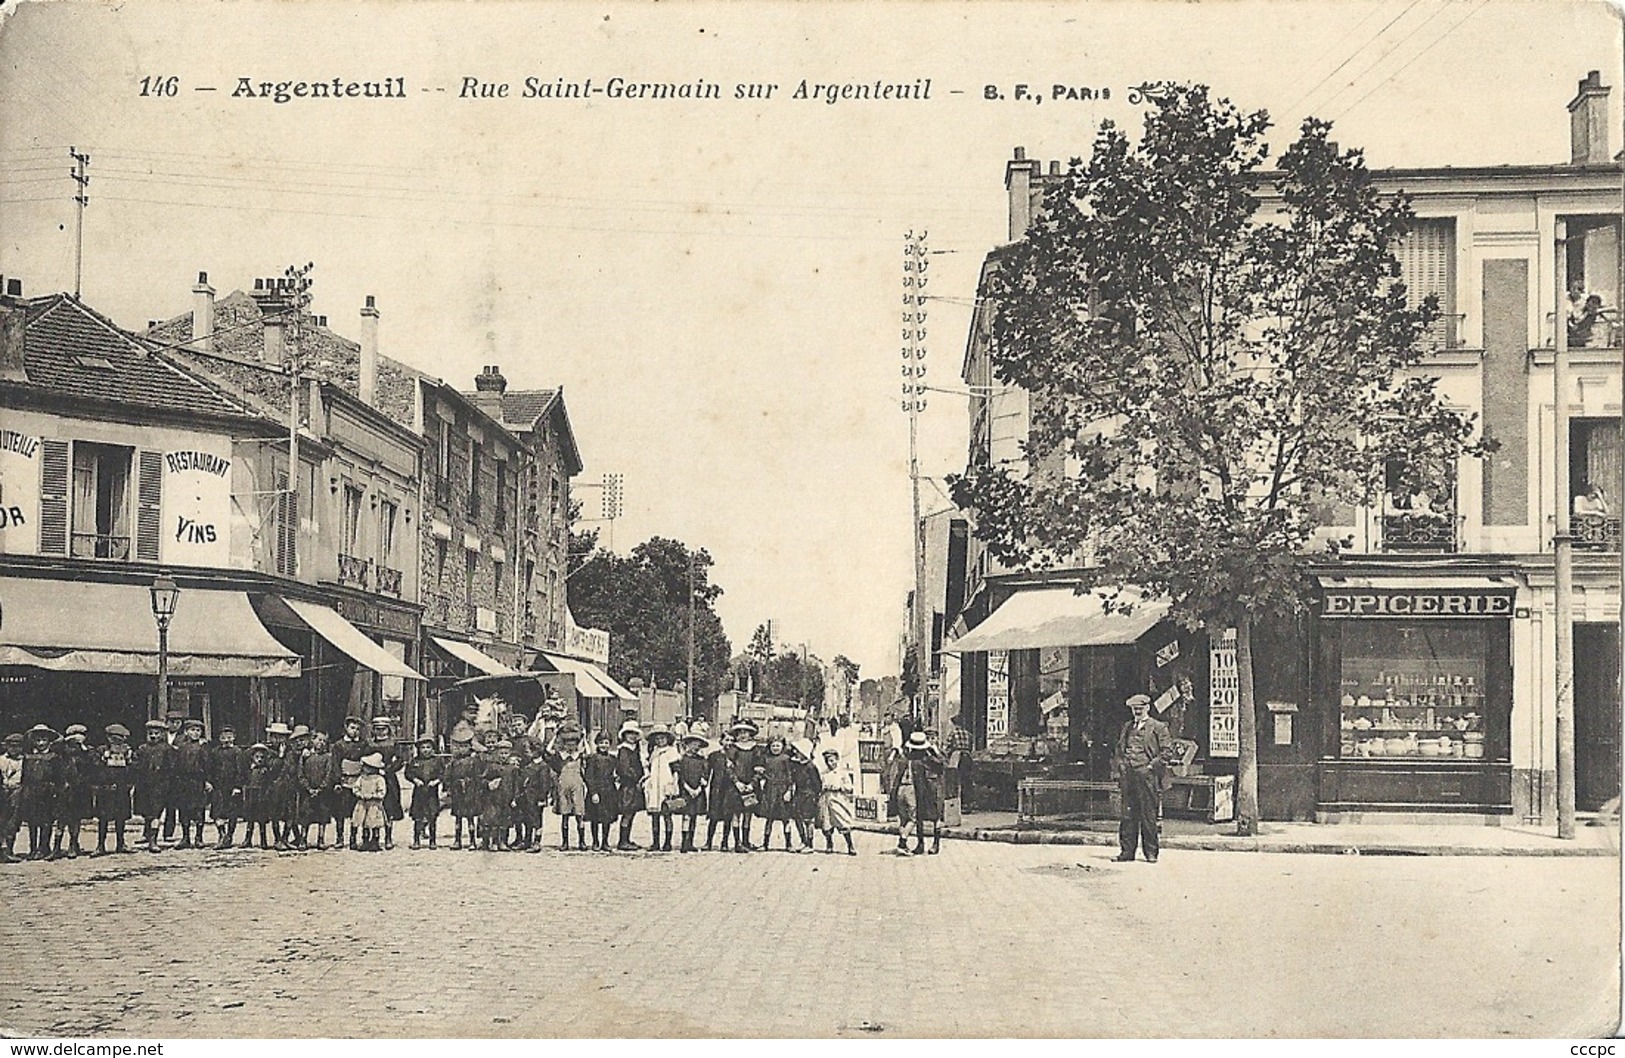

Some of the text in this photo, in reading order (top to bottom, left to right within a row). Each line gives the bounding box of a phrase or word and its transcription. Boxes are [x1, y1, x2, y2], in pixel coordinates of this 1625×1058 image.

[0, 429, 40, 459] UTEILLE
[165, 451, 231, 478] RESTAURANT
[175, 515, 217, 544] VINS
[1326, 595, 1510, 613] EPICERIE
[1214, 652, 1234, 668] 10
[1213, 689, 1235, 705] 20
